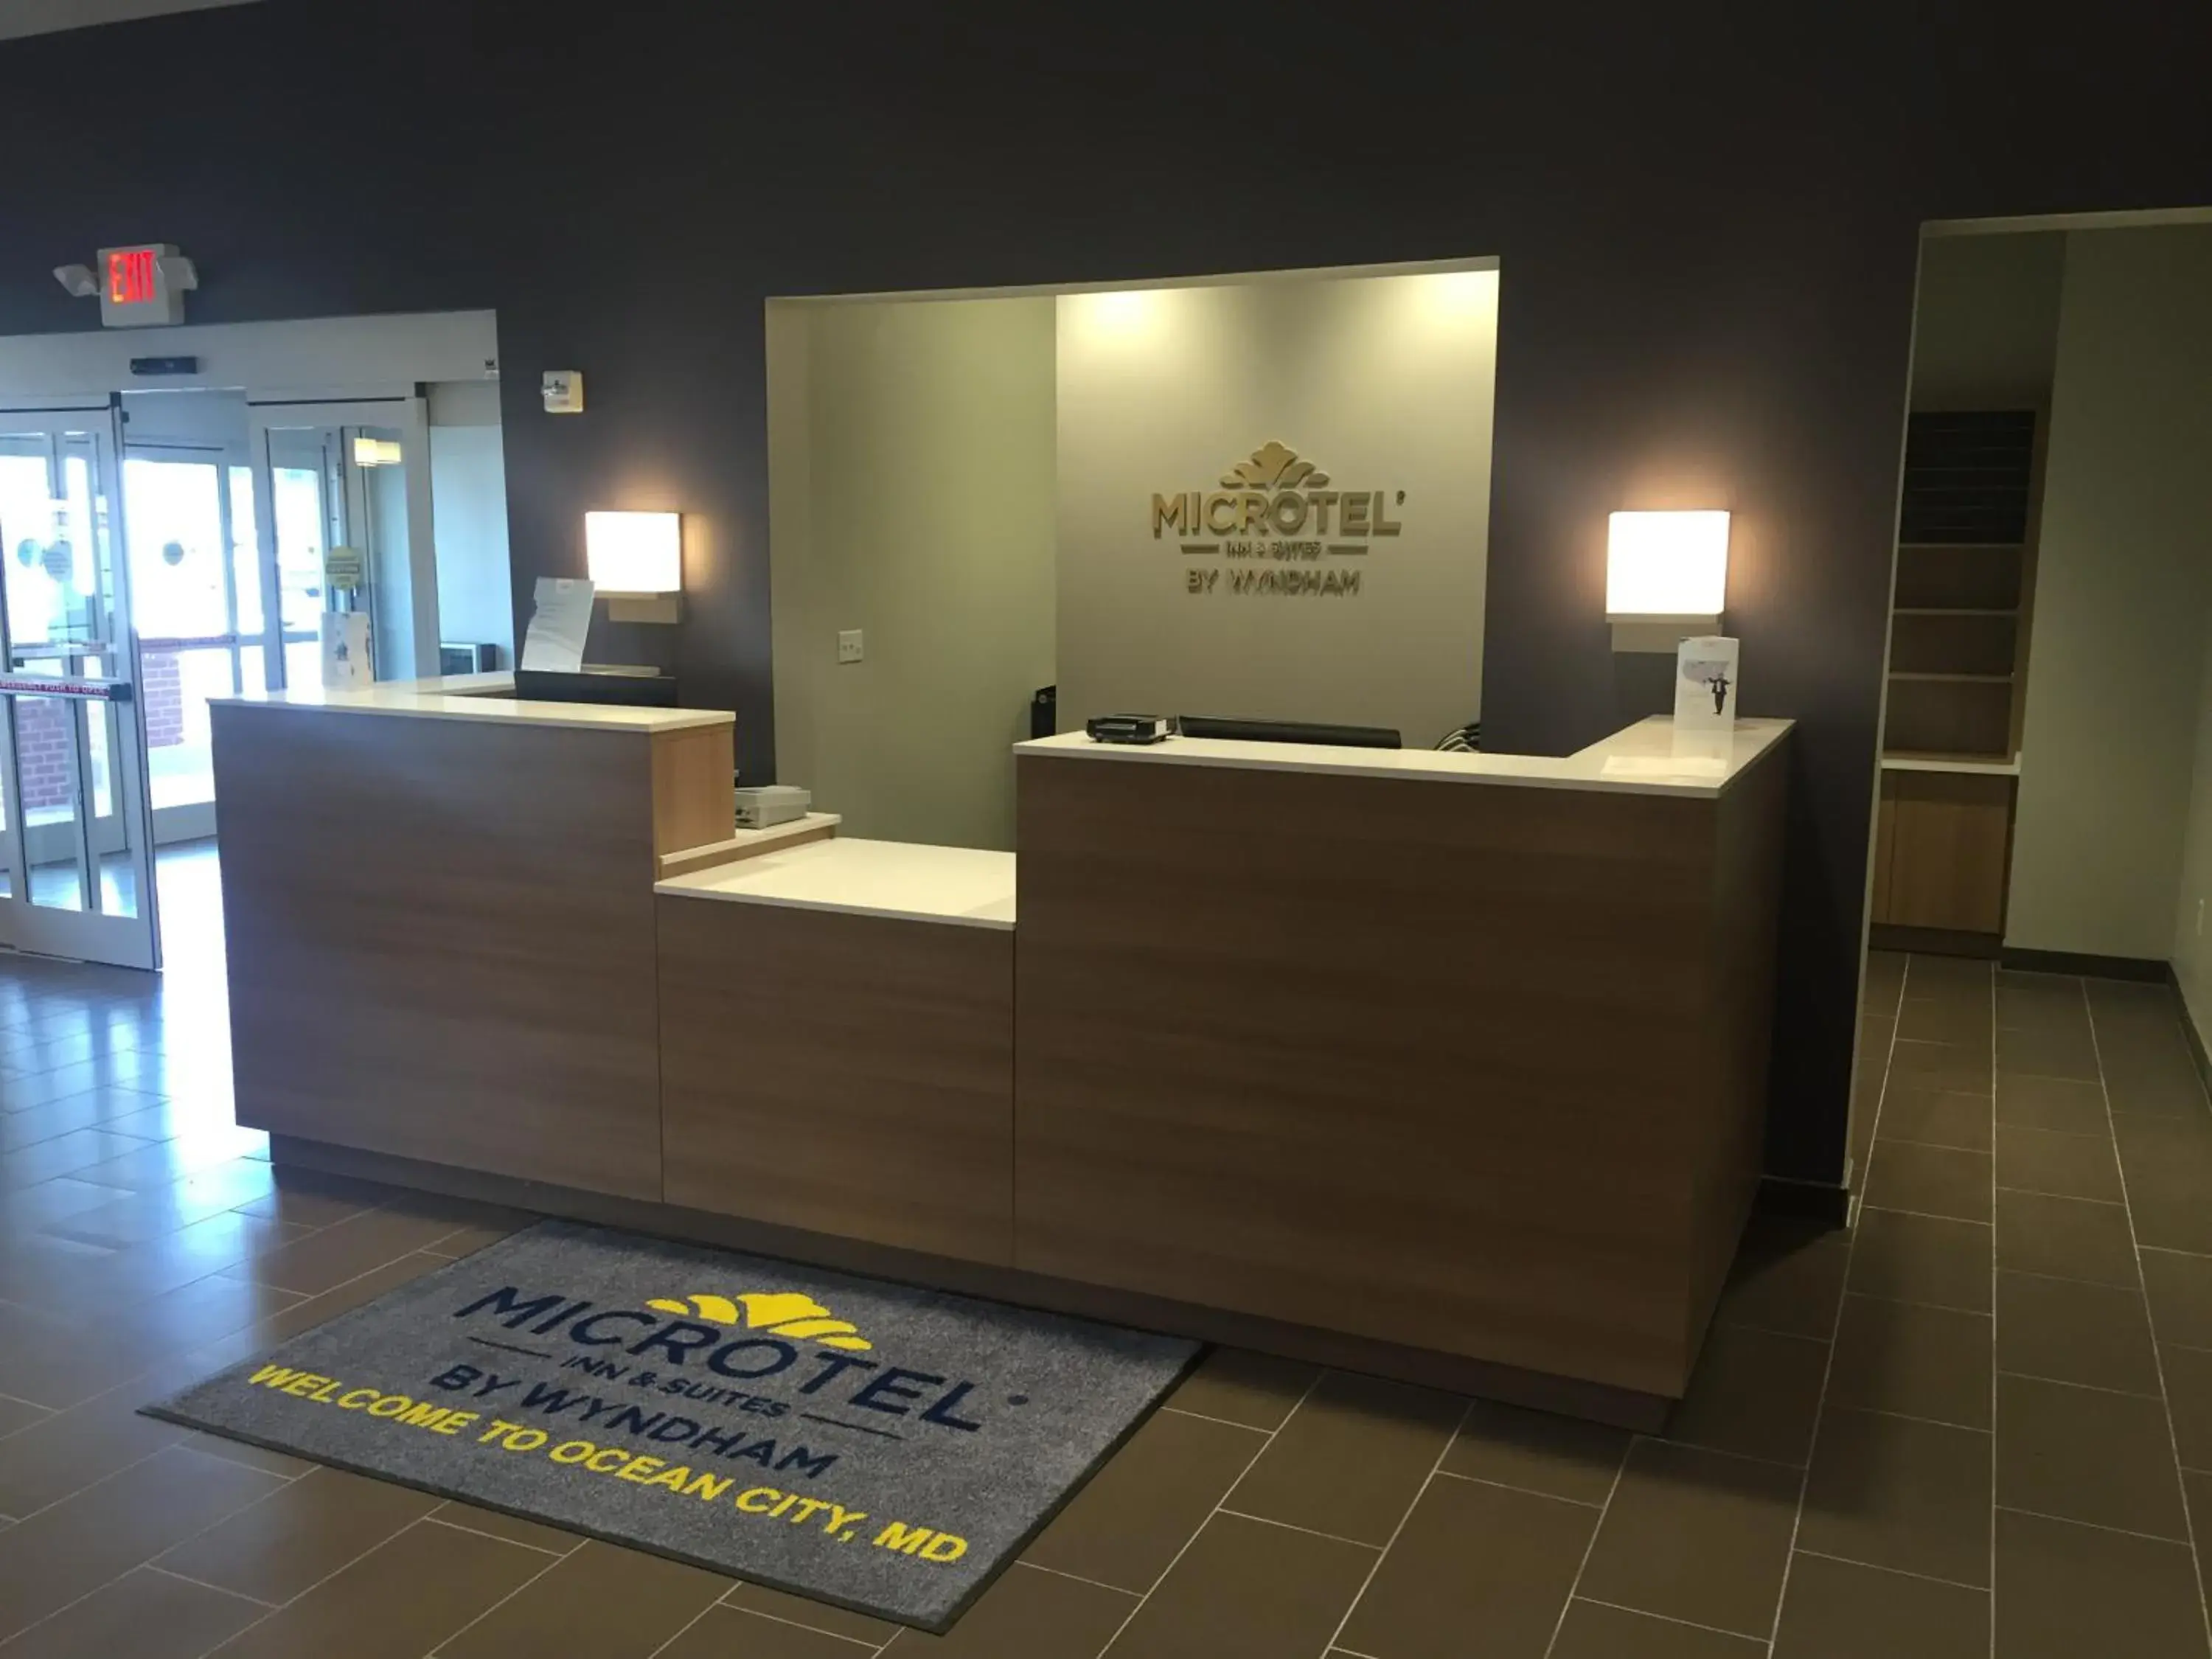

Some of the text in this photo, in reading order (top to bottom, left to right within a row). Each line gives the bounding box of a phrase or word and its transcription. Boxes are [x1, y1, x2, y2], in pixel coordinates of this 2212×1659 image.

[108, 251, 156, 303] EXIT
[1152, 490, 1402, 539] MICROTEL
[1225, 540, 1252, 558] INN
[1270, 540, 1322, 561] SUITES
[1186, 568, 1362, 597] BY WYNDHAM
[453, 1286, 981, 1432] MICROTEL
[560, 1355, 791, 1417] INN & SUITES
[430, 1363, 839, 1478] BY WYNDHAM
[248, 1363, 969, 1562] WELCOME TO OCEAN CITY, MD
